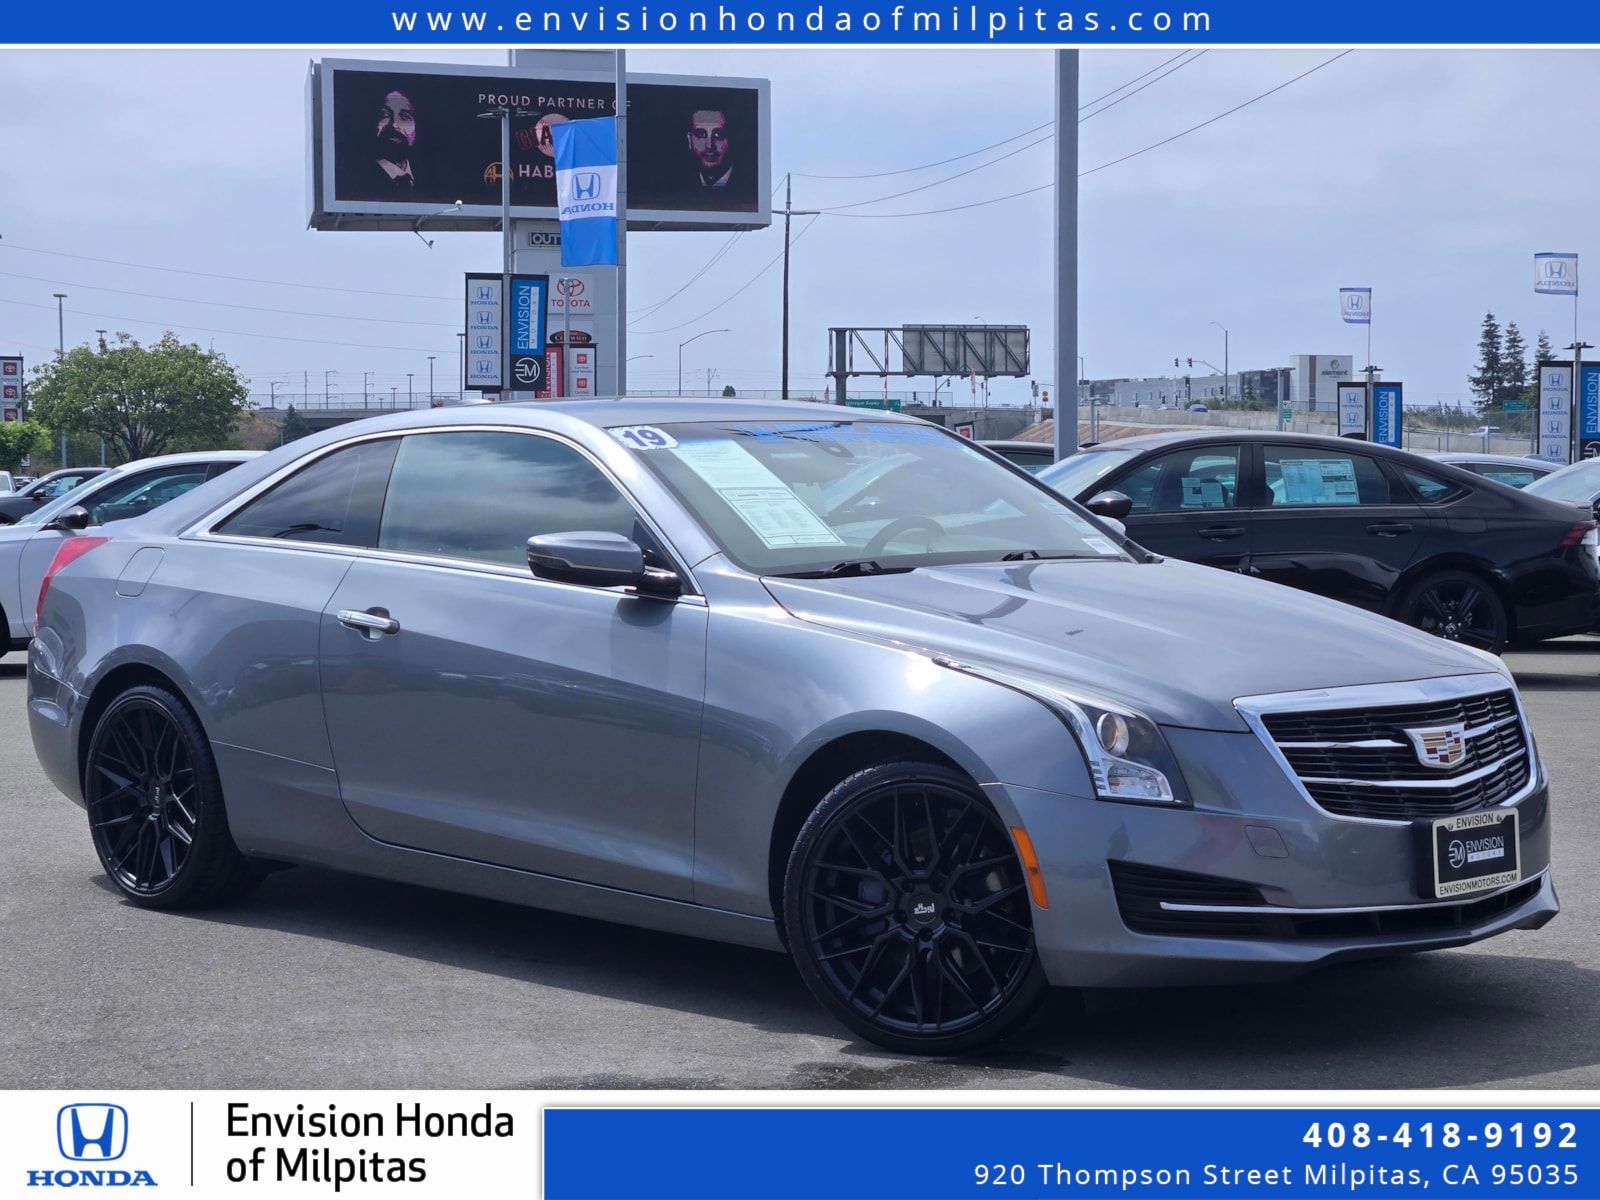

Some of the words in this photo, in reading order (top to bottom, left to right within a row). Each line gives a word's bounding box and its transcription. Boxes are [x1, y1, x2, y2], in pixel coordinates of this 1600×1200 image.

[479, 93, 531, 106] PROUD
[538, 96, 605, 109] PARTNER
[519, 164, 554, 178] HAB
[532, 233, 560, 244] OUT
[551, 299, 591, 308] TOOTA
[517, 285, 531, 350] ENVISION
[1587, 372, 1598, 433] ENVISION
[1379, 391, 1388, 443] ENVISION
[623, 429, 667, 447] 19
[1456, 813, 1494, 828] ENVISION
[1466, 835, 1505, 853] ENVISION
[1440, 873, 1517, 895] ENVISIONMOTORS.COM
